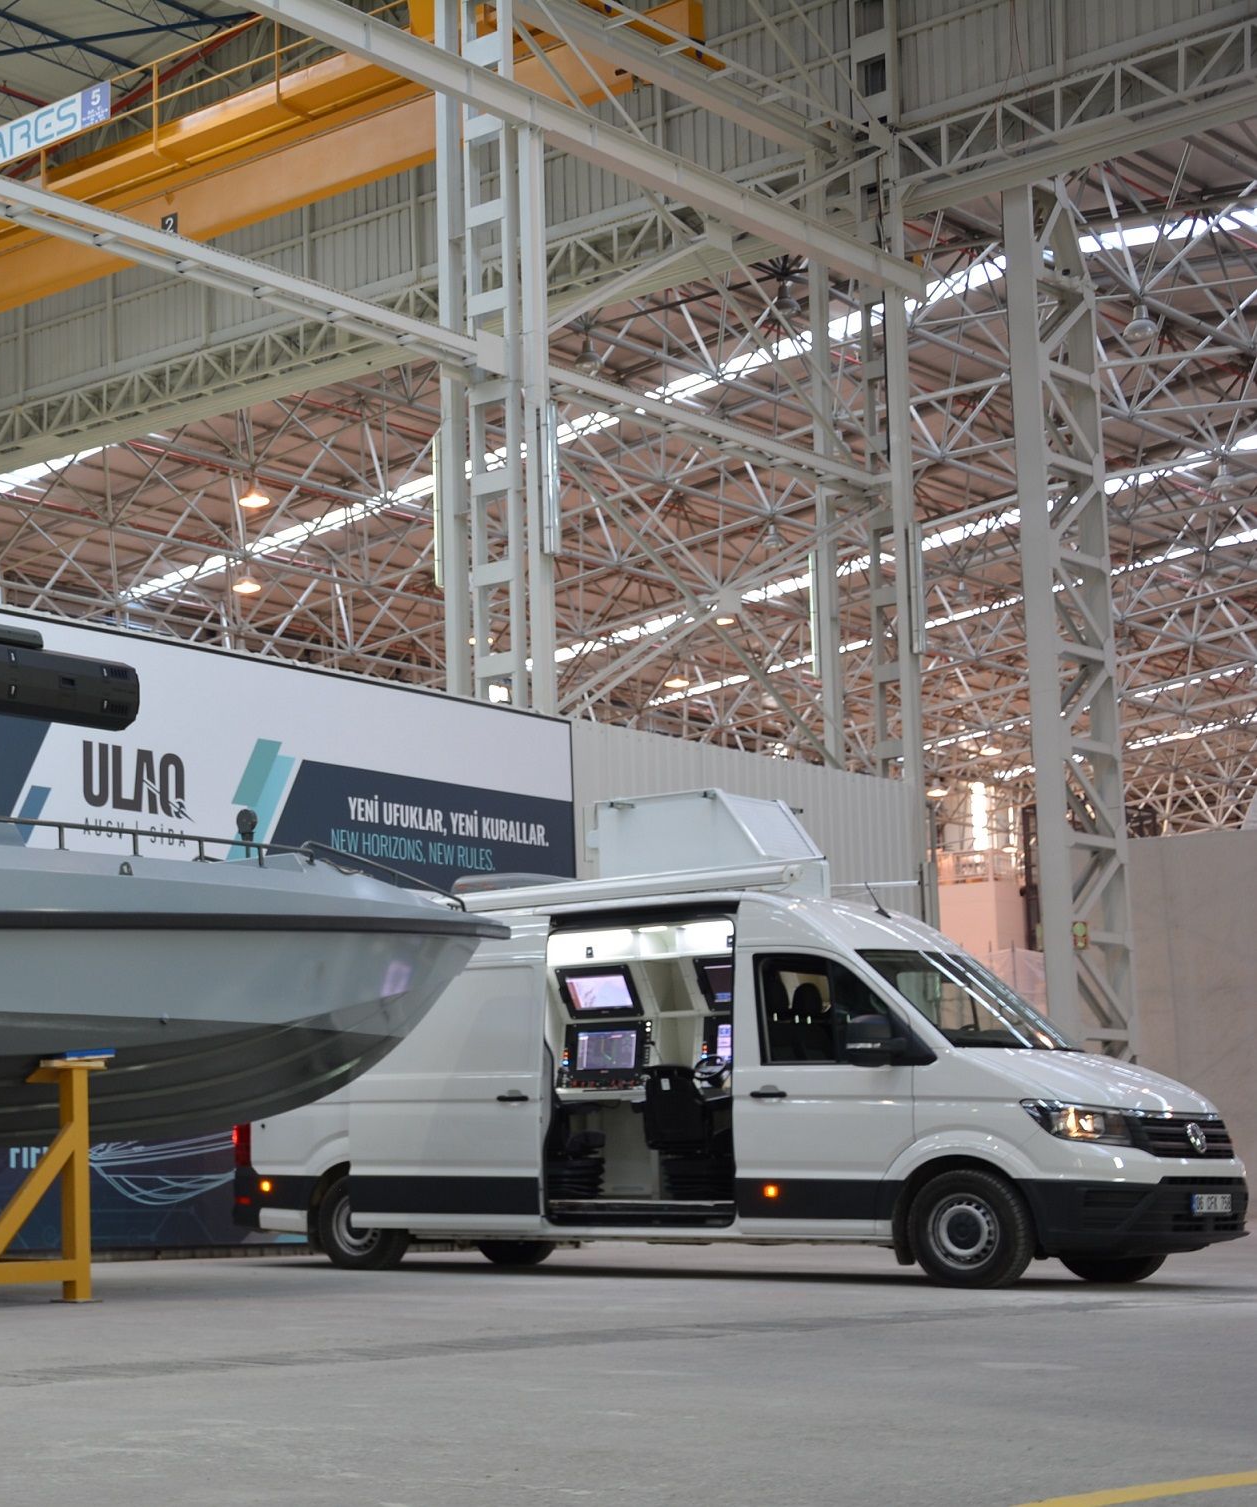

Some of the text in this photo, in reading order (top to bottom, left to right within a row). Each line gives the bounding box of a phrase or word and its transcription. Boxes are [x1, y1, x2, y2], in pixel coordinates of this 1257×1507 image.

[91, 88, 101, 106] 5
[165, 217, 174, 233] 2
[82, 739, 193, 821] ULAQ
[82, 817, 125, 840] AUSV
[347, 794, 550, 847] YENİ UFUKLAR, YENİ KURALLAR.
[330, 828, 496, 871] NEW HORIZONS, NEW RULES.
